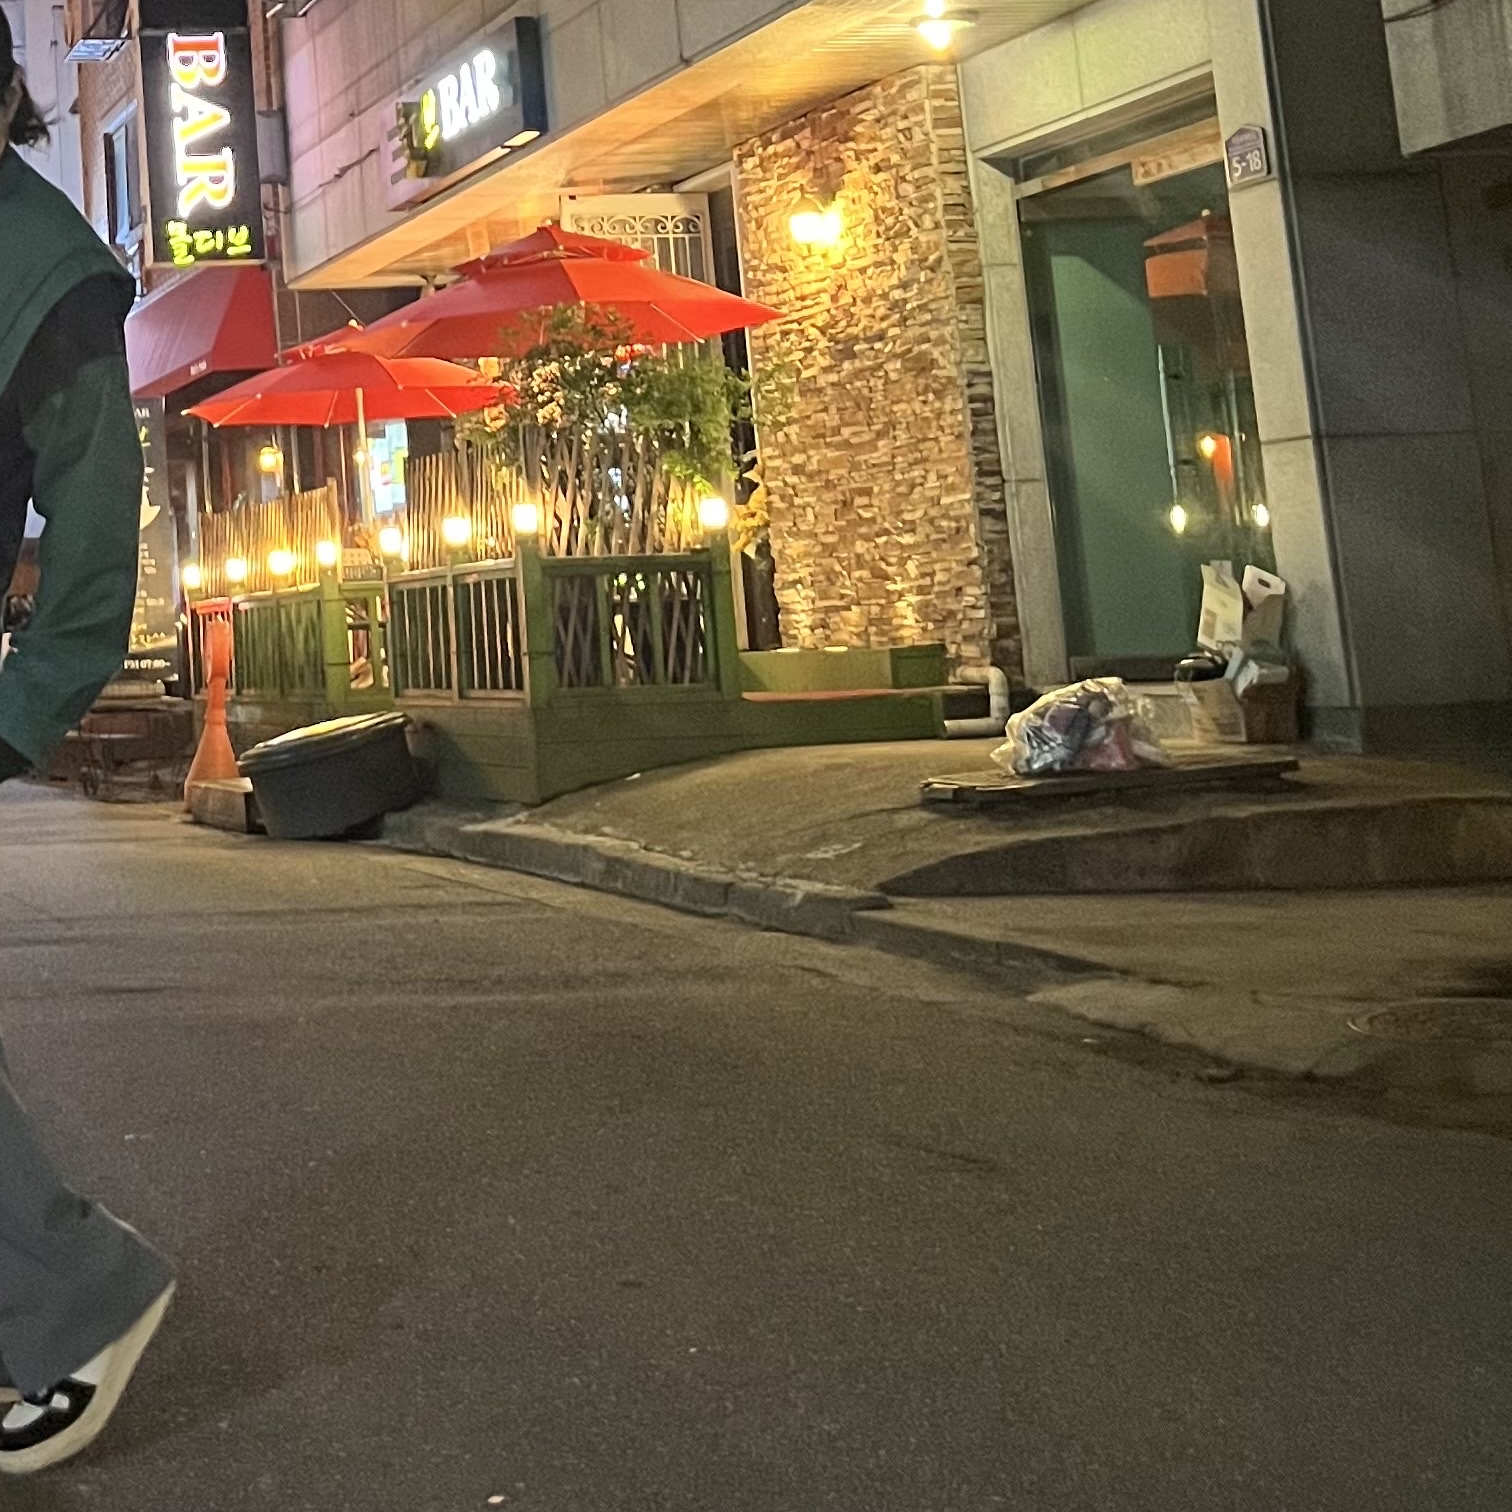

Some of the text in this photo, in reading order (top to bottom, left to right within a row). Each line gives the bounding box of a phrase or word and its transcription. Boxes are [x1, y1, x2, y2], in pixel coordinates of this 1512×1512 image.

[167, 31, 236, 219] BAR
[437, 49, 500, 140] BAR
[1232, 149, 1262, 177] 5-18
